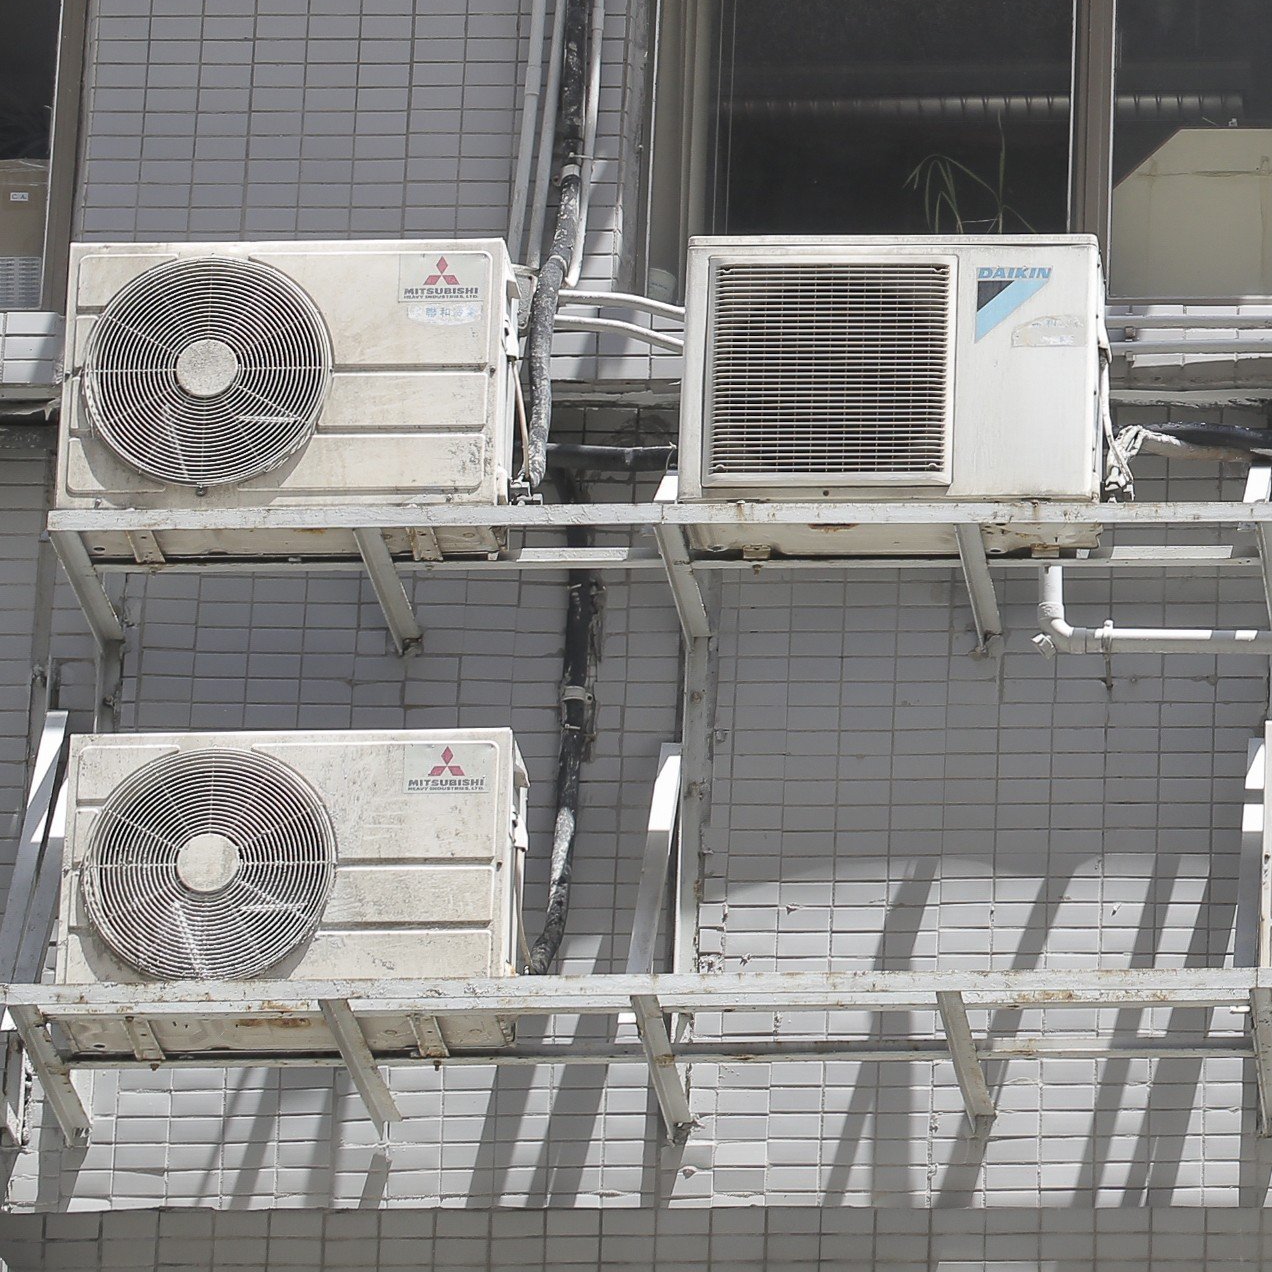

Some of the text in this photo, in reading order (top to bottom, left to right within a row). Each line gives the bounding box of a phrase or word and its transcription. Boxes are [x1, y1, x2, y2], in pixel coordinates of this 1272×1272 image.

[978, 267, 1052, 279] DAIKIN
[403, 287, 479, 295] MITSUBISHI
[408, 778, 484, 787] MITSUBISHI
